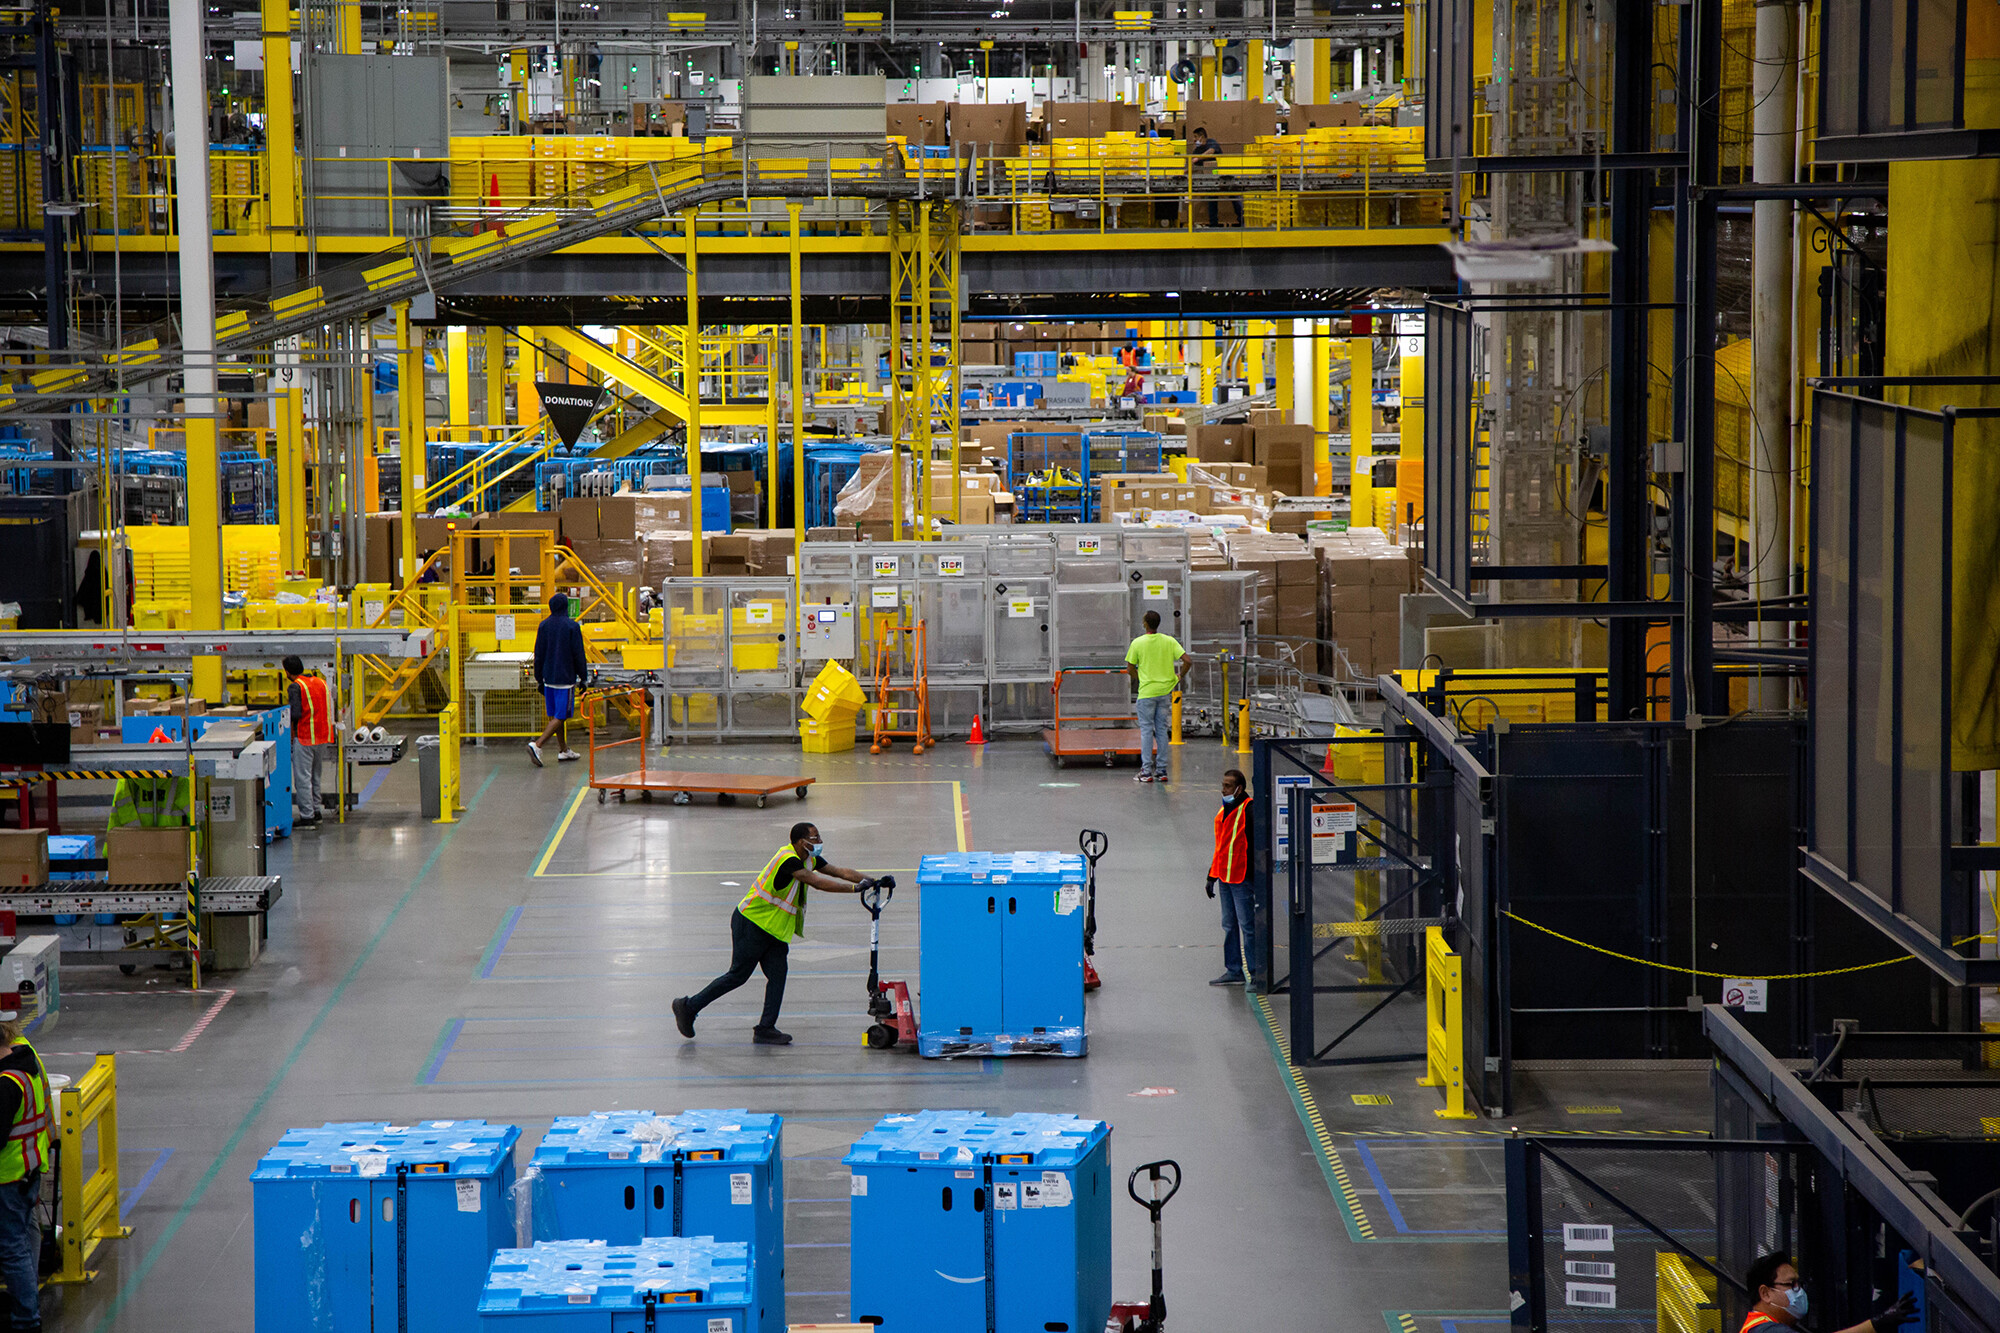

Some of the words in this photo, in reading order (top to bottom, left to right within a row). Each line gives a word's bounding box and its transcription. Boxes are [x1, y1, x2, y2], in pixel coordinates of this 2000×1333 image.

[1409, 337, 1418, 352] 8
[282, 367, 293, 382] 9
[544, 395, 594, 408] DONATIONS
[875, 561, 897, 569] STOP!
[941, 561, 962, 569] STOP!
